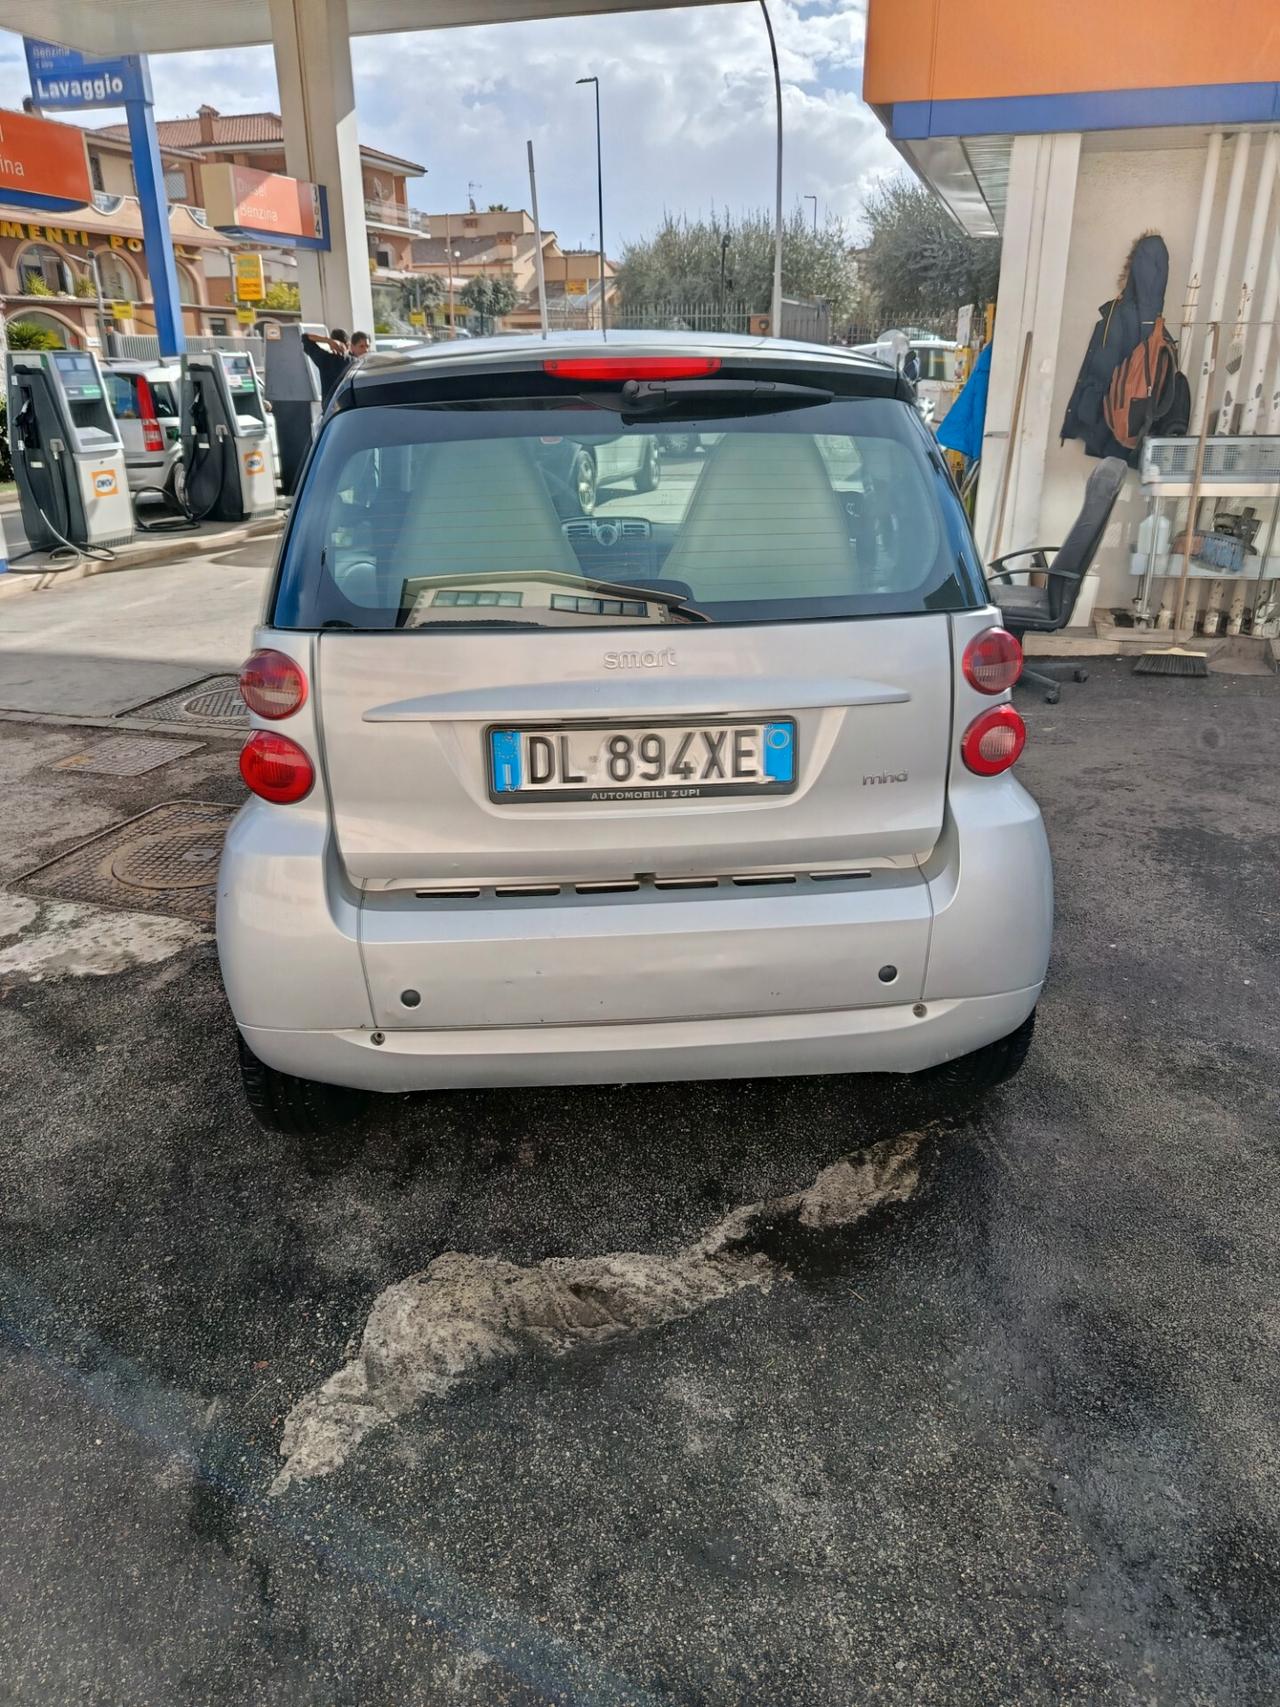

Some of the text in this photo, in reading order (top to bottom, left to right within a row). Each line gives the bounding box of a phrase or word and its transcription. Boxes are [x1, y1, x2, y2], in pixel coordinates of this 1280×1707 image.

[36, 72, 123, 100] Lavaggio
[239, 203, 279, 222] Benzina
[603, 647, 677, 670] smart
[528, 734, 588, 785] DL
[607, 729, 758, 783] 894XE
[590, 789, 701, 801] AUTOMOBILI ZUPI
